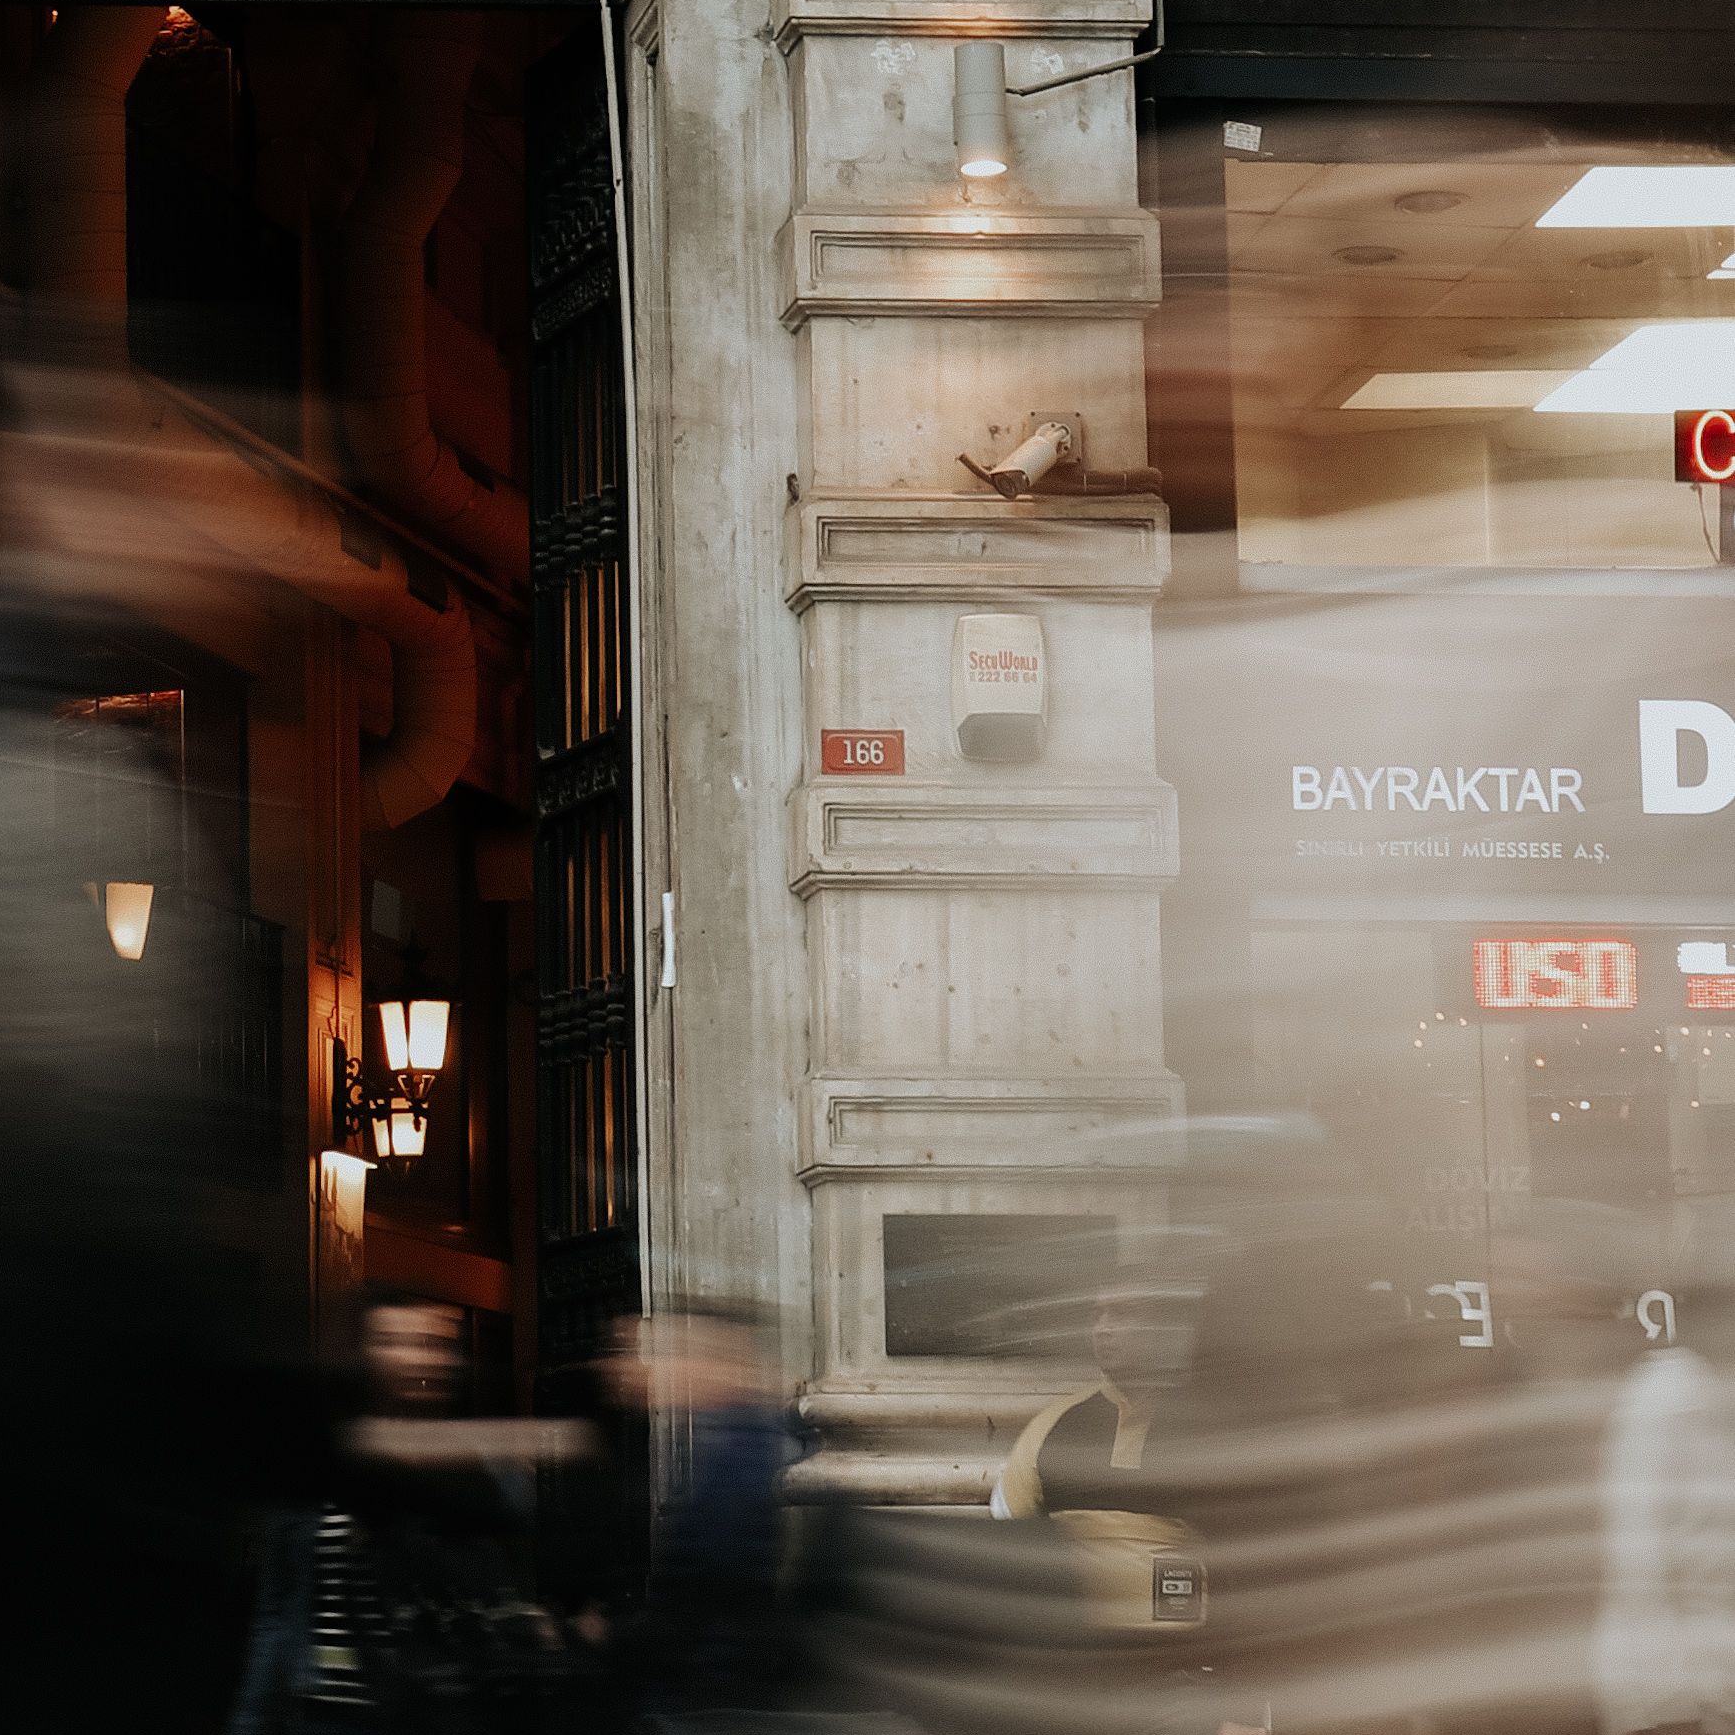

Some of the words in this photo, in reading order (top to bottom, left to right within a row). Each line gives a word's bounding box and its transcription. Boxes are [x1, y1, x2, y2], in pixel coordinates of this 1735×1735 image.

[843, 739, 885, 765] 166
[1292, 765, 1587, 814] BAYRAKTAR
[1376, 836, 1451, 858] YETKİLİ
[1462, 837, 1563, 859] MÜESSESE
[1573, 841, 1611, 864] A.Ş.
[1424, 1157, 1531, 1193] DÖVİZ
